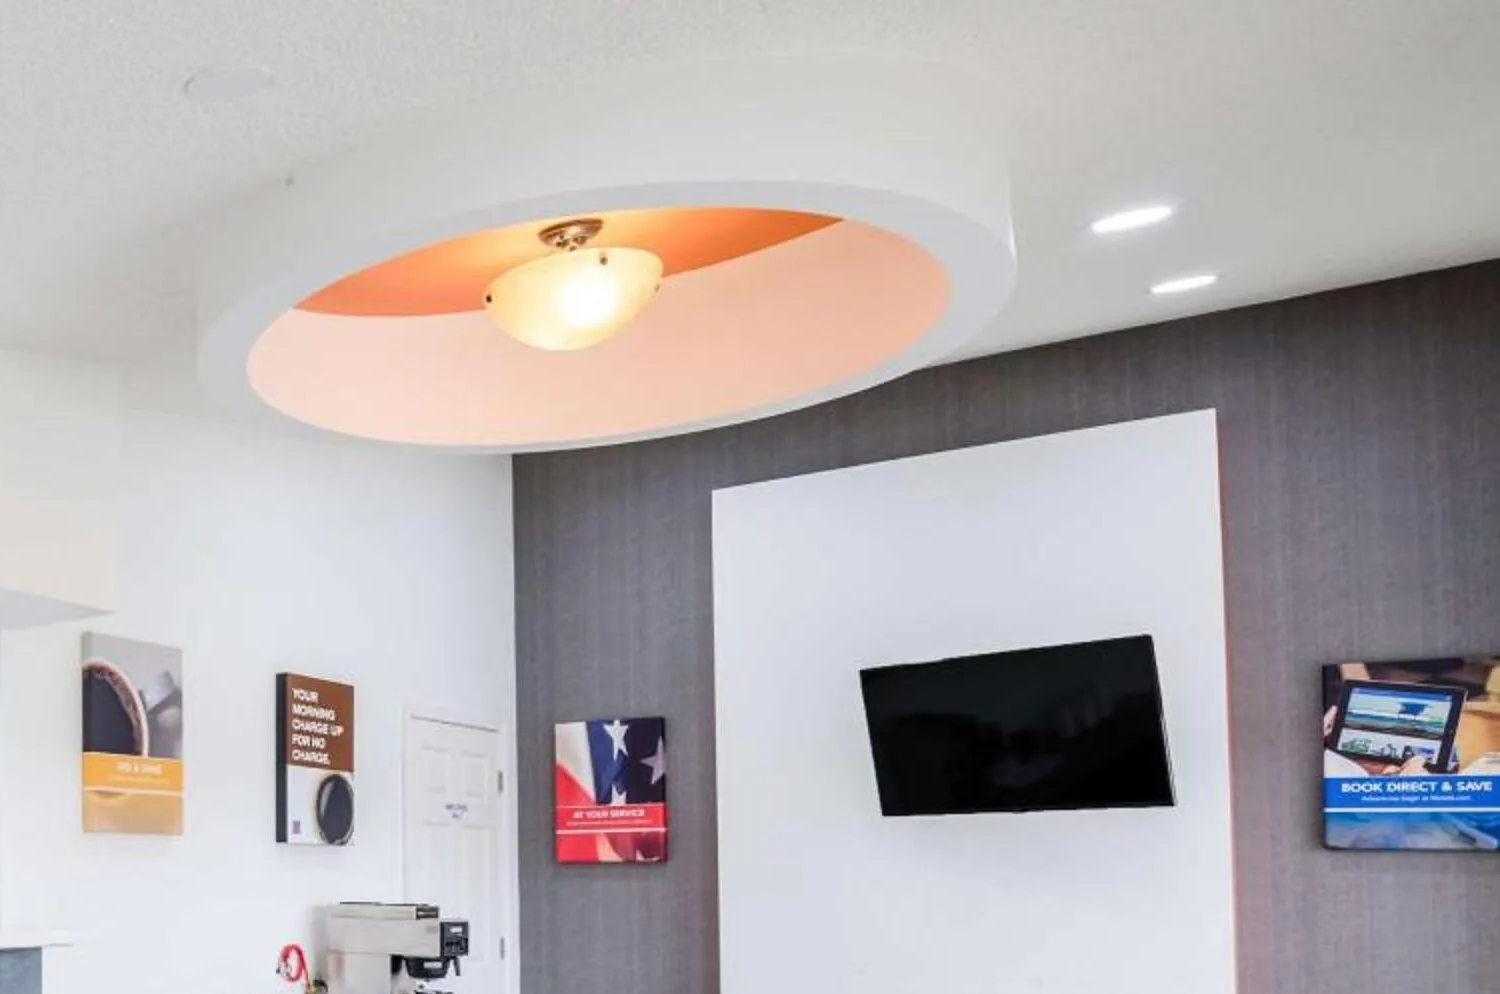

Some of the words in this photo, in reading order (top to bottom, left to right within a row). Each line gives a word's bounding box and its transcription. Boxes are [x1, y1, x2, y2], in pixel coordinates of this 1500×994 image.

[292, 688, 318, 703] YOUR
[292, 704, 335, 721] MORNING
[292, 719, 328, 735] CHARGE
[292, 734, 311, 747] FOR
[311, 735, 326, 749] NO
[1341, 782, 1382, 793] BOOK
[1387, 781, 1437, 792] DIRECT
[1441, 781, 1452, 792] &
[1457, 781, 1493, 792] SAVE
